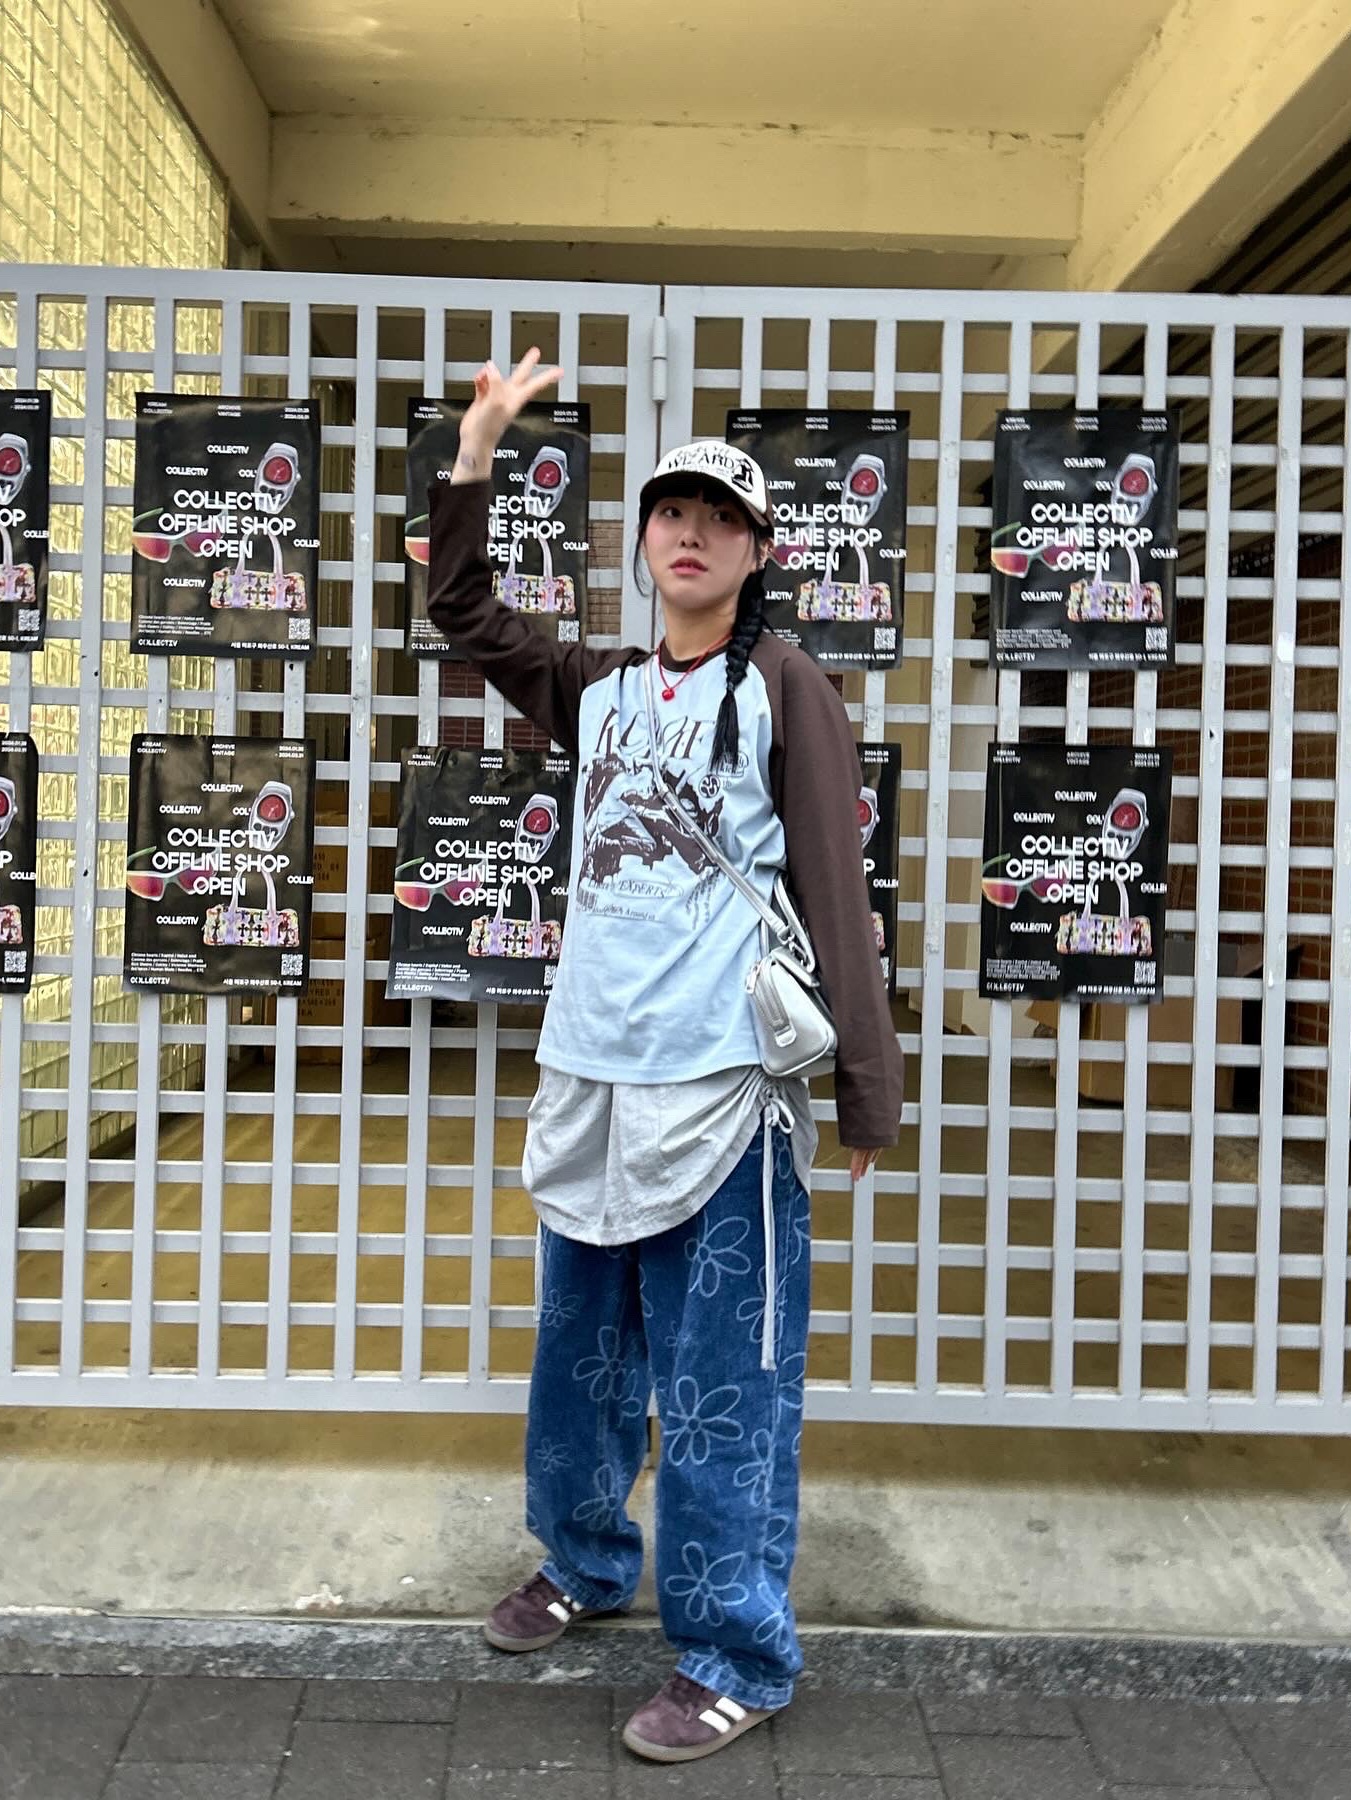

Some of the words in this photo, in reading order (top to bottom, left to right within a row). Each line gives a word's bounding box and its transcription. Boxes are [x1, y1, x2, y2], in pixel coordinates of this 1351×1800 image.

[207, 445, 249, 454] COLLECTIV
[493, 449, 519, 459] LECTIV
[166, 466, 208, 476] COLLECTIV
[794, 458, 836, 468] COLLECTIV
[1064, 458, 1106, 468] COLLECTIV
[766, 481, 796, 490] LLECTIV
[1023, 480, 1066, 490] COLLECTIV
[174, 489, 281, 510] COLLECTIV
[1031, 503, 1139, 523] COLLECTIV
[158, 513, 237, 534] OFFLINE
[240, 516, 296, 536] SHOP
[511, 520, 565, 539] SHOP
[774, 527, 824, 547] FLINE
[828, 527, 882, 547] SHOP
[1016, 527, 1094, 547] OFFLINE
[1098, 527, 1153, 548] SHOP
[200, 539, 253, 558] OPEN
[487, 543, 523, 563] PEN
[788, 551, 840, 571] OPEN
[1056, 551, 1110, 572] OPEN
[163, 578, 206, 587] COLLECTIV
[1021, 591, 1063, 601] COLLECTIV
[201, 784, 243, 792] COLLECTIV
[1055, 791, 1096, 801] COLLECTIV
[159, 805, 202, 814] COLLECTIV
[469, 796, 510, 805] COLLECTIV
[428, 817, 469, 826] COLLECTIV
[1014, 813, 1055, 823] COLLECTIV
[167, 828, 275, 848] COLLECTIV
[1021, 835, 1129, 857] COLLECTIV
[435, 839, 540, 860] COLLECTIV
[152, 852, 231, 872] OFFLINE
[234, 854, 290, 873] SHOP
[1006, 858, 1084, 879] OFFLINE
[1088, 860, 1143, 882] SHOP
[420, 862, 497, 883] OFFLINE
[500, 865, 554, 884] SHOP
[193, 877, 246, 896] OPEN
[1047, 883, 1099, 904] OPEN
[460, 887, 511, 907] OPEN
[156, 915, 198, 925] COLLECTIV
[1010, 922, 1052, 933] COLLECTIV
[422, 926, 463, 936] COLLECTIV
